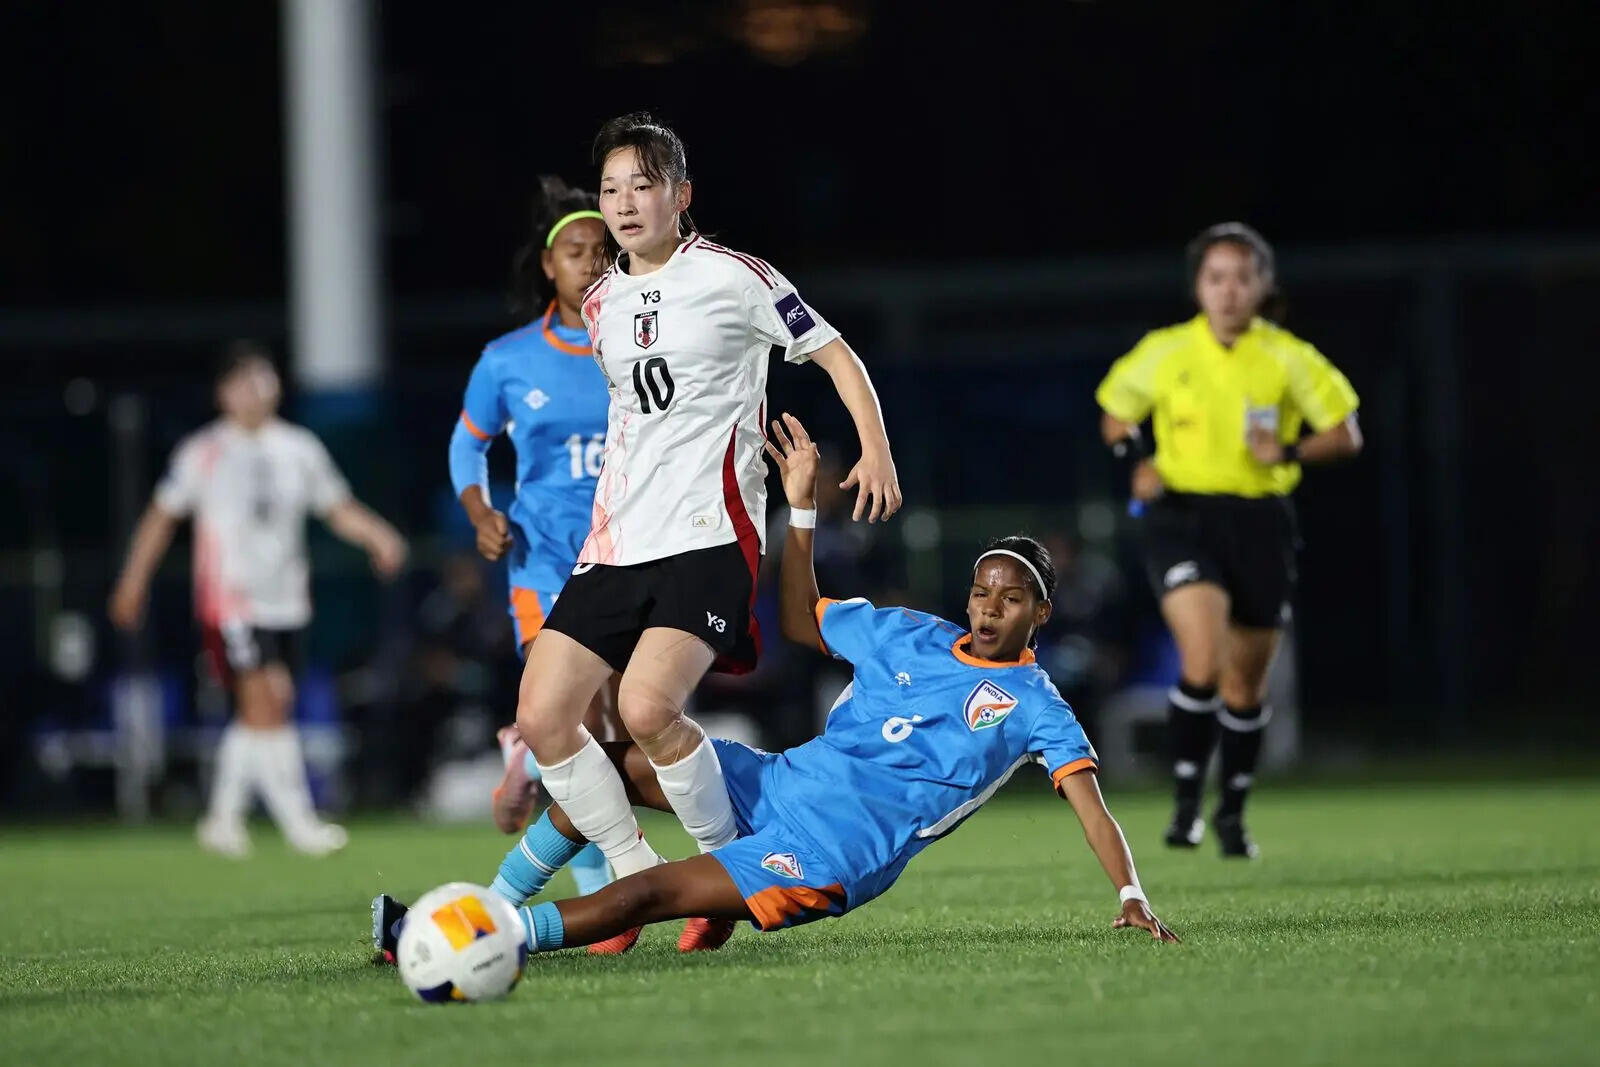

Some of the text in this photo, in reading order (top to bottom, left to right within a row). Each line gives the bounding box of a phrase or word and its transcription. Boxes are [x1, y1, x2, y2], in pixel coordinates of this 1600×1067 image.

[641, 290, 661, 305] Y-3
[786, 304, 804, 325] AFC
[632, 357, 676, 414] 10
[565, 433, 605, 479] 16
[705, 611, 727, 633] Y-3
[983, 686, 1003, 703] INDIA
[881, 714, 923, 743] 6
